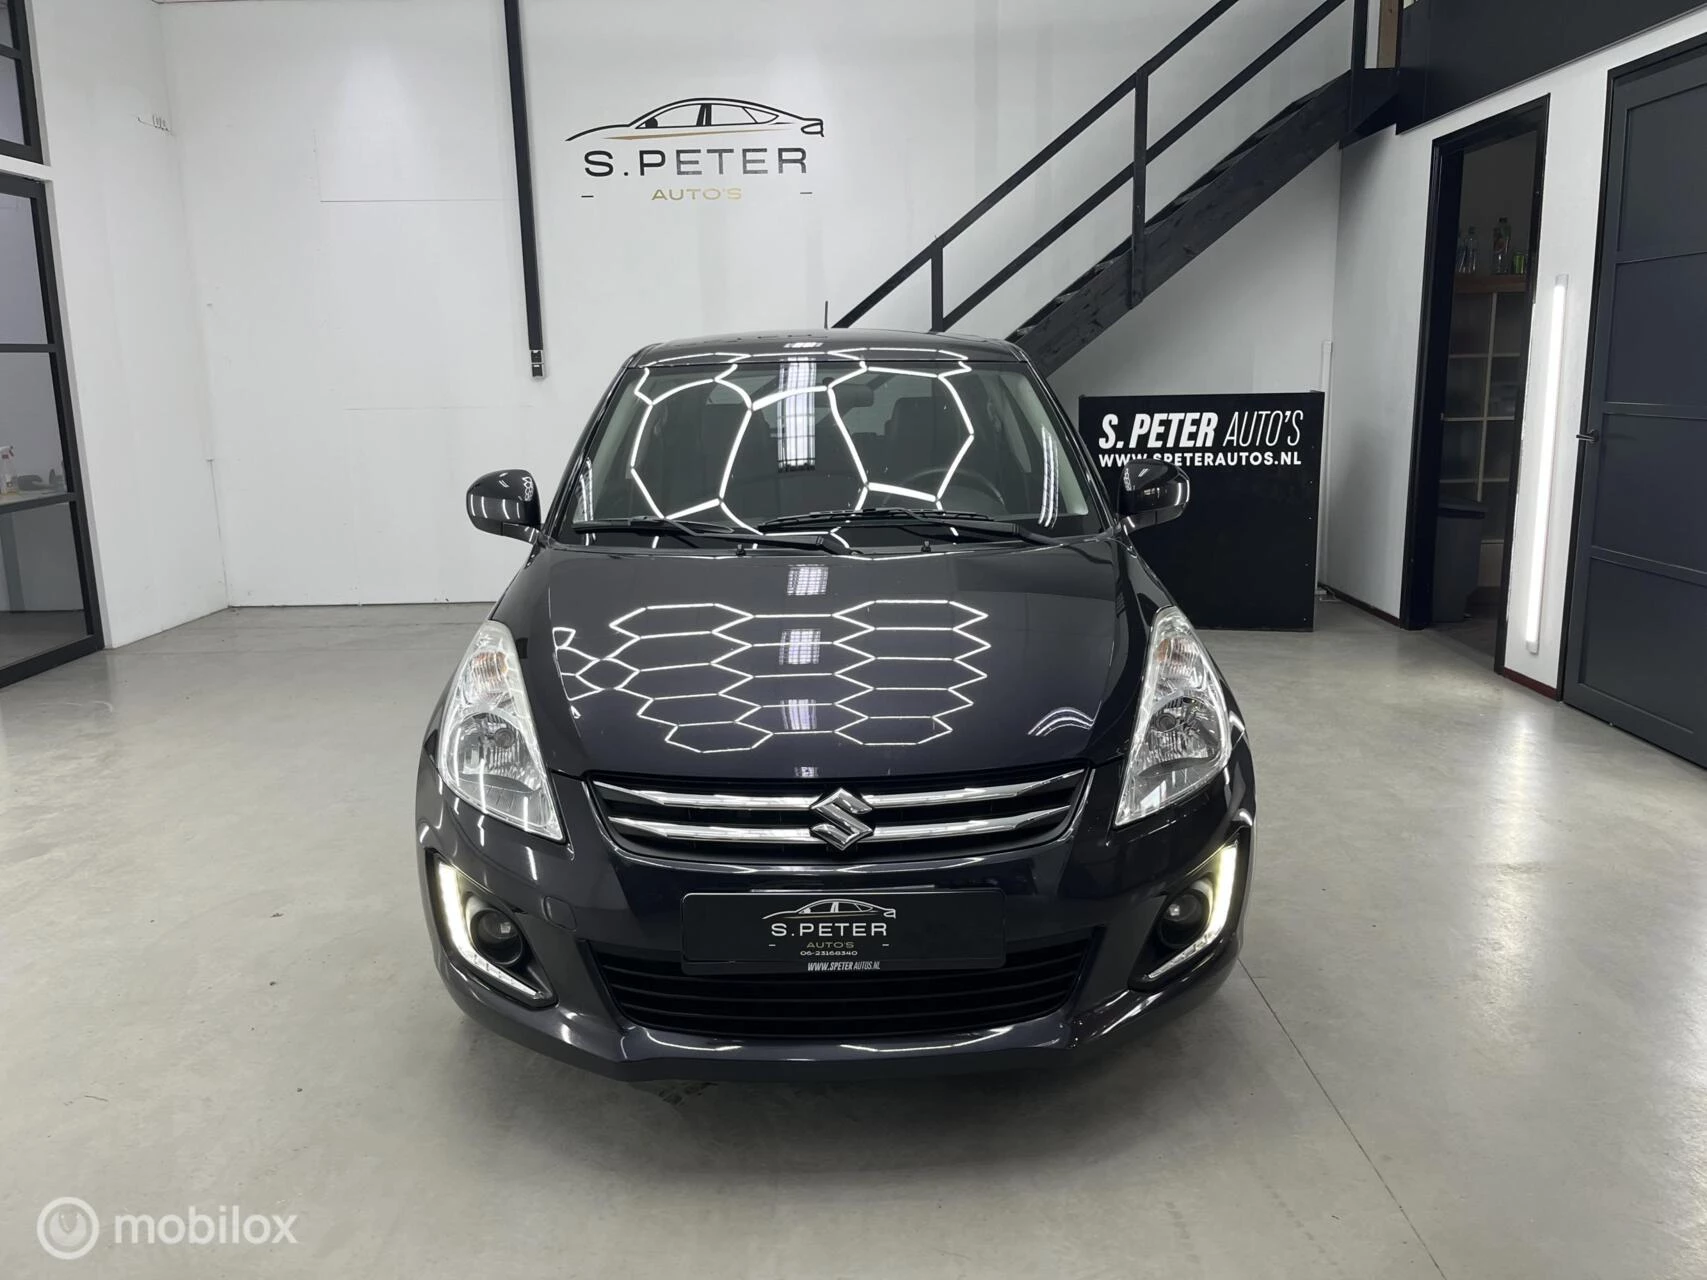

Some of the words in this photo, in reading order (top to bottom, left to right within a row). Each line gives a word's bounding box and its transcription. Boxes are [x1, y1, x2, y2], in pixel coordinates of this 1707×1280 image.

[583, 147, 807, 177] S.PETER
[651, 187, 742, 201] AUTO'S
[1222, 410, 1304, 447] AUTO'S
[1098, 451, 1302, 467] WWSPETERAUTOS.NL
[771, 922, 887, 937] S.PETER
[806, 941, 854, 949] AUTO'S
